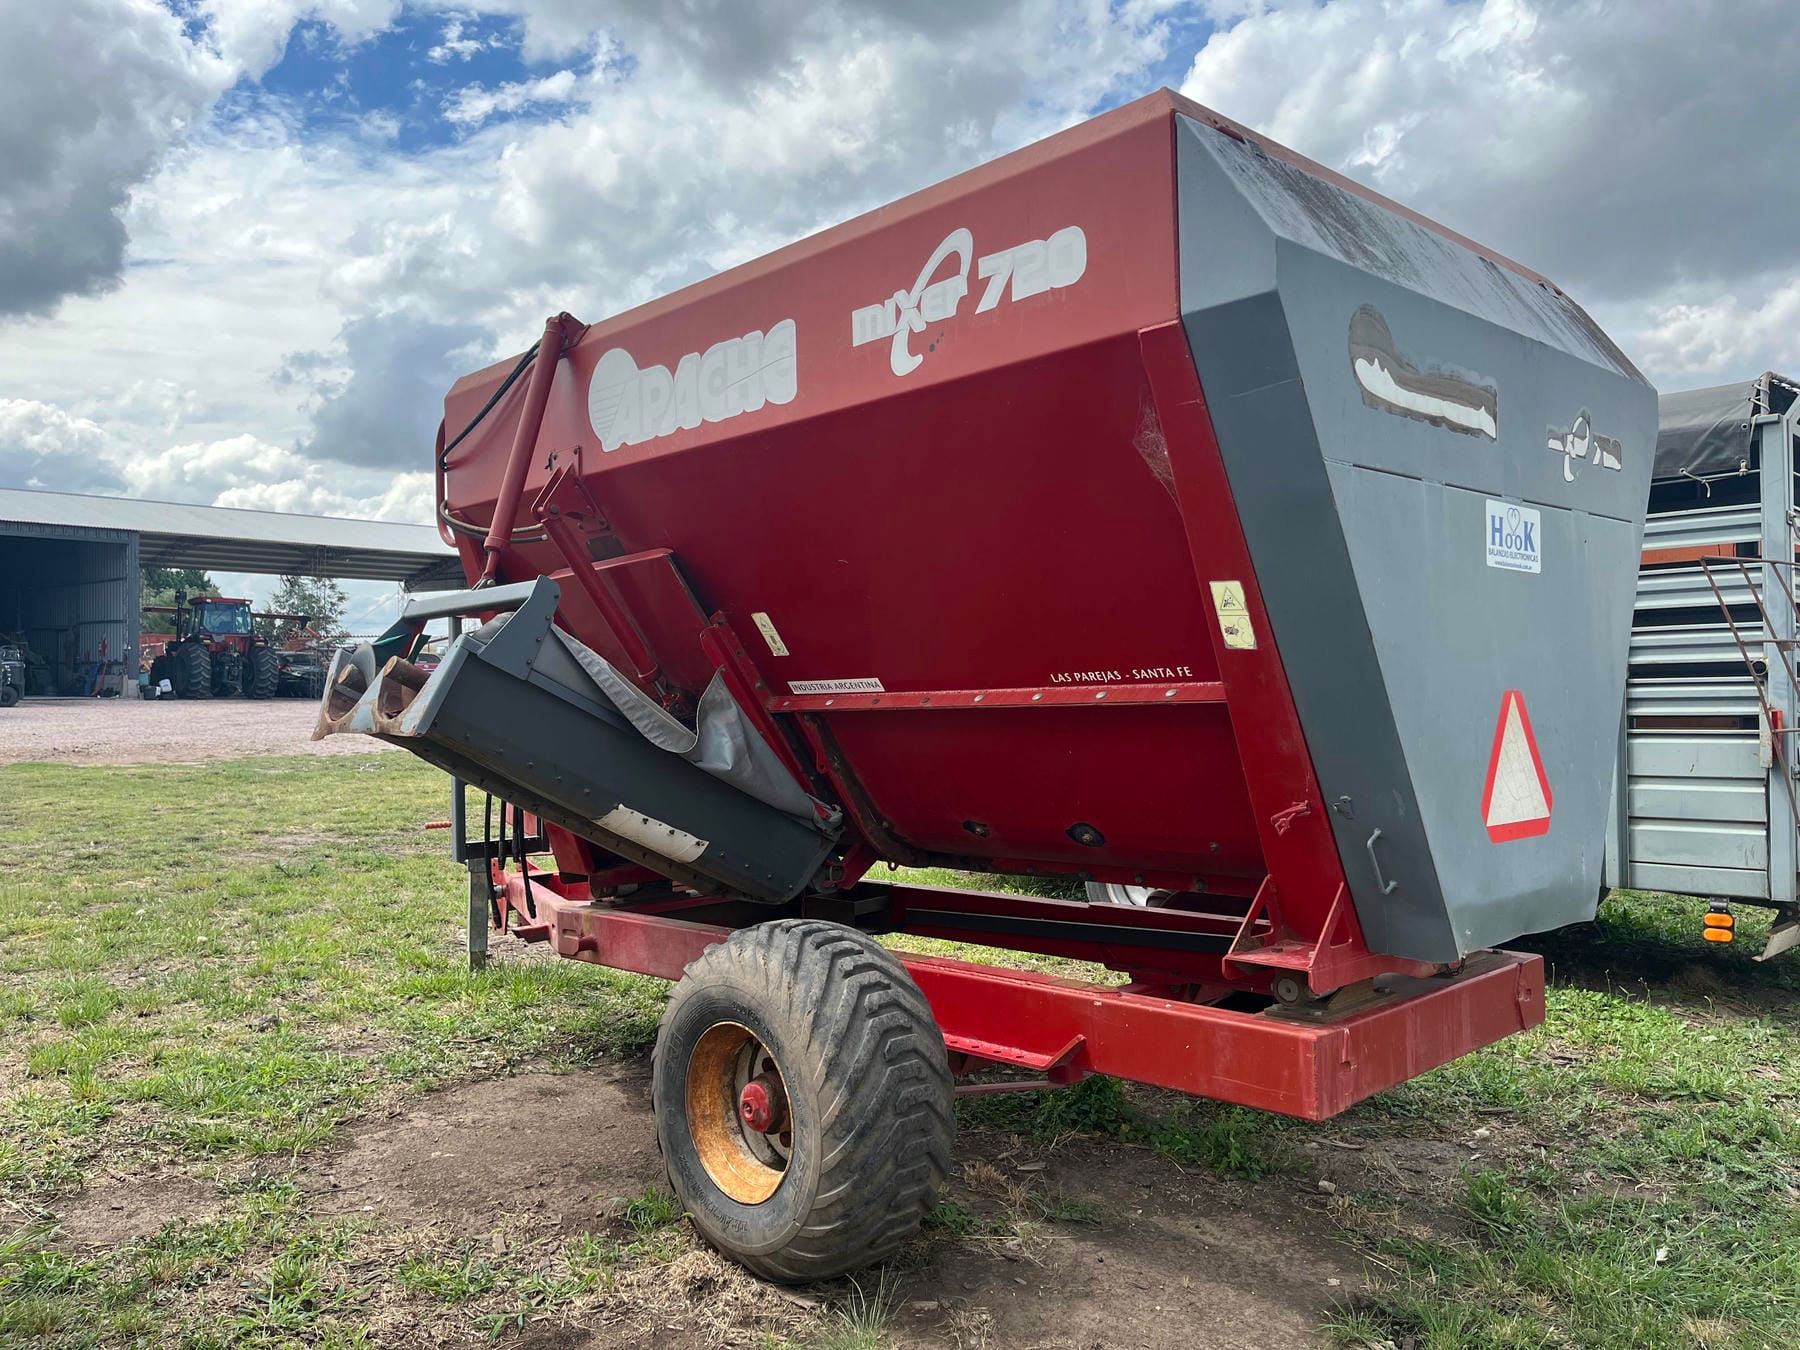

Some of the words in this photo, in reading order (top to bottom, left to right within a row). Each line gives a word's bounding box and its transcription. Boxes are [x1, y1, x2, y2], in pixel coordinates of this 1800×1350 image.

[976, 225, 1087, 314] 720
[1050, 672, 1072, 683] LAS
[1073, 670, 1122, 683] PAREJAS
[1132, 667, 1175, 680] SANTA
[1176, 666, 1193, 678] FE
[791, 682, 833, 692] INDUSTRIA
[834, 680, 882, 691] ARGENTINA
